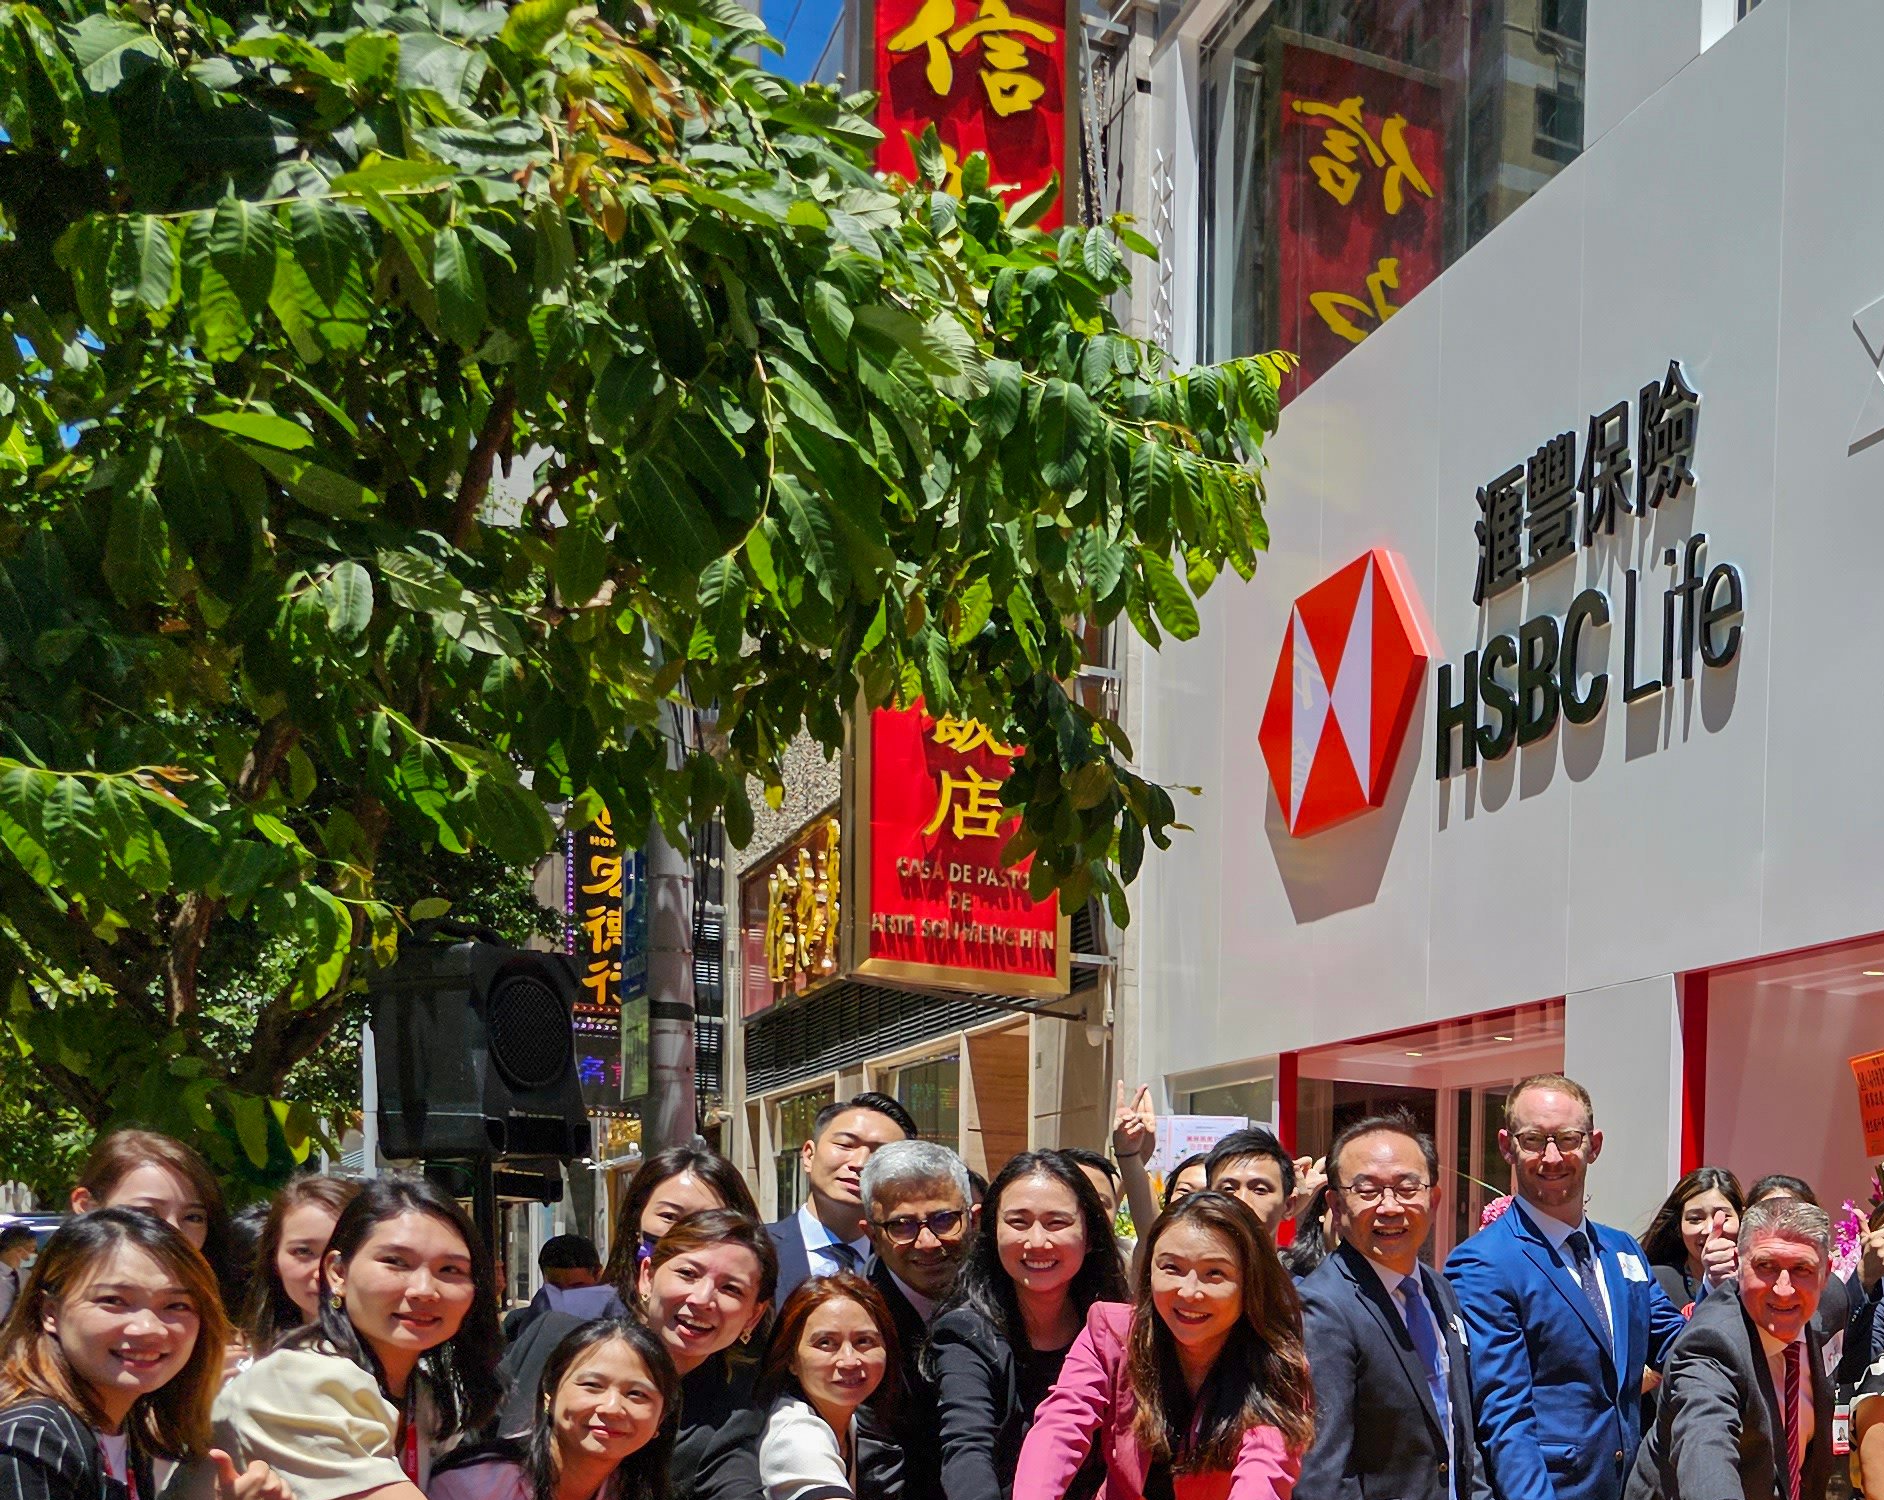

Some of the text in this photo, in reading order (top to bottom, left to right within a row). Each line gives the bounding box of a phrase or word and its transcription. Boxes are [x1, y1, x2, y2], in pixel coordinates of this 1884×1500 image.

[1472, 358, 1702, 607] 滙豐保險
[1435, 532, 1745, 781] HSBC Life
[895, 856, 945, 880] CASA
[949, 862, 972, 884] DE
